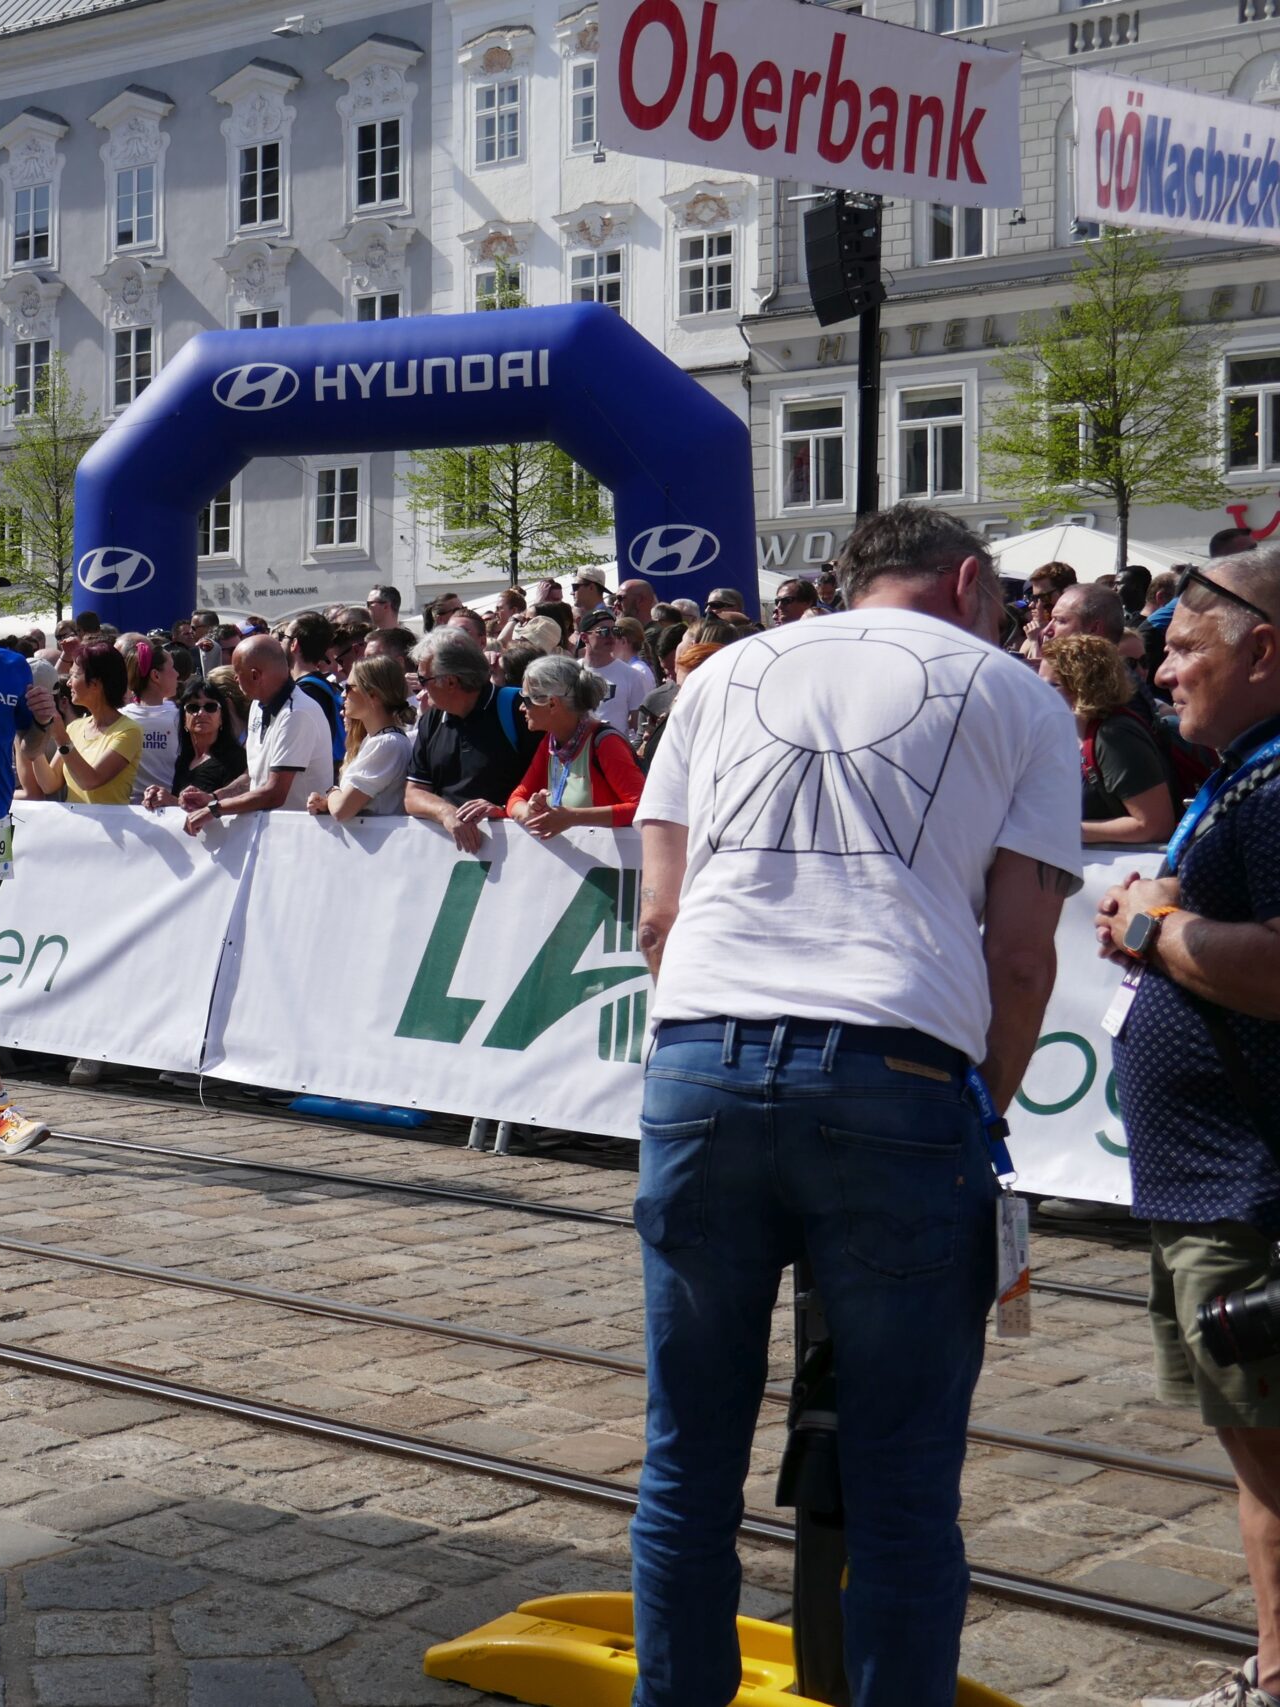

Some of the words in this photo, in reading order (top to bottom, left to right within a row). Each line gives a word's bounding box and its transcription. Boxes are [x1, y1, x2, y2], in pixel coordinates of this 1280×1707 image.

[618, 0, 987, 184] Oberbank
[315, 349, 550, 402] HYUNDAI
[254, 589, 268, 598] EINE
[269, 586, 319, 598] BUCHHANDLUNG
[143, 731, 168, 741] olin
